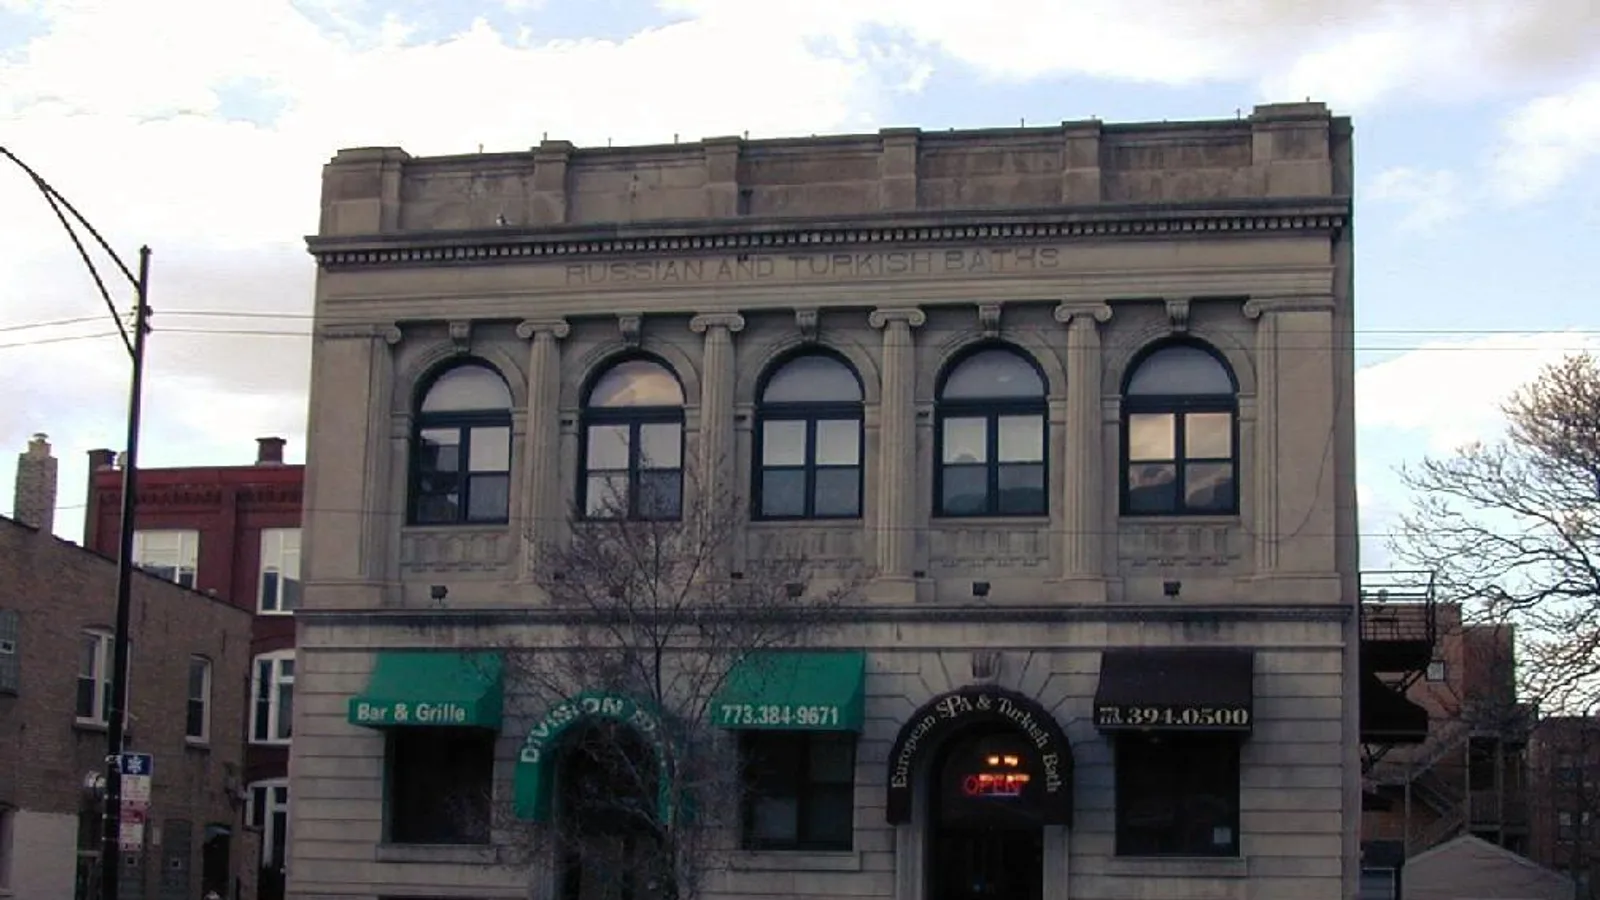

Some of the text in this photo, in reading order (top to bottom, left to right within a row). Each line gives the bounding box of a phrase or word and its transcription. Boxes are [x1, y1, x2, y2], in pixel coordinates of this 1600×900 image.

[357, 702, 466, 721] Bar & Grille
[891, 715, 936, 788] European
[976, 693, 992, 710] &
[997, 696, 1052, 749] Turkish
[1042, 751, 1063, 792] Bath
